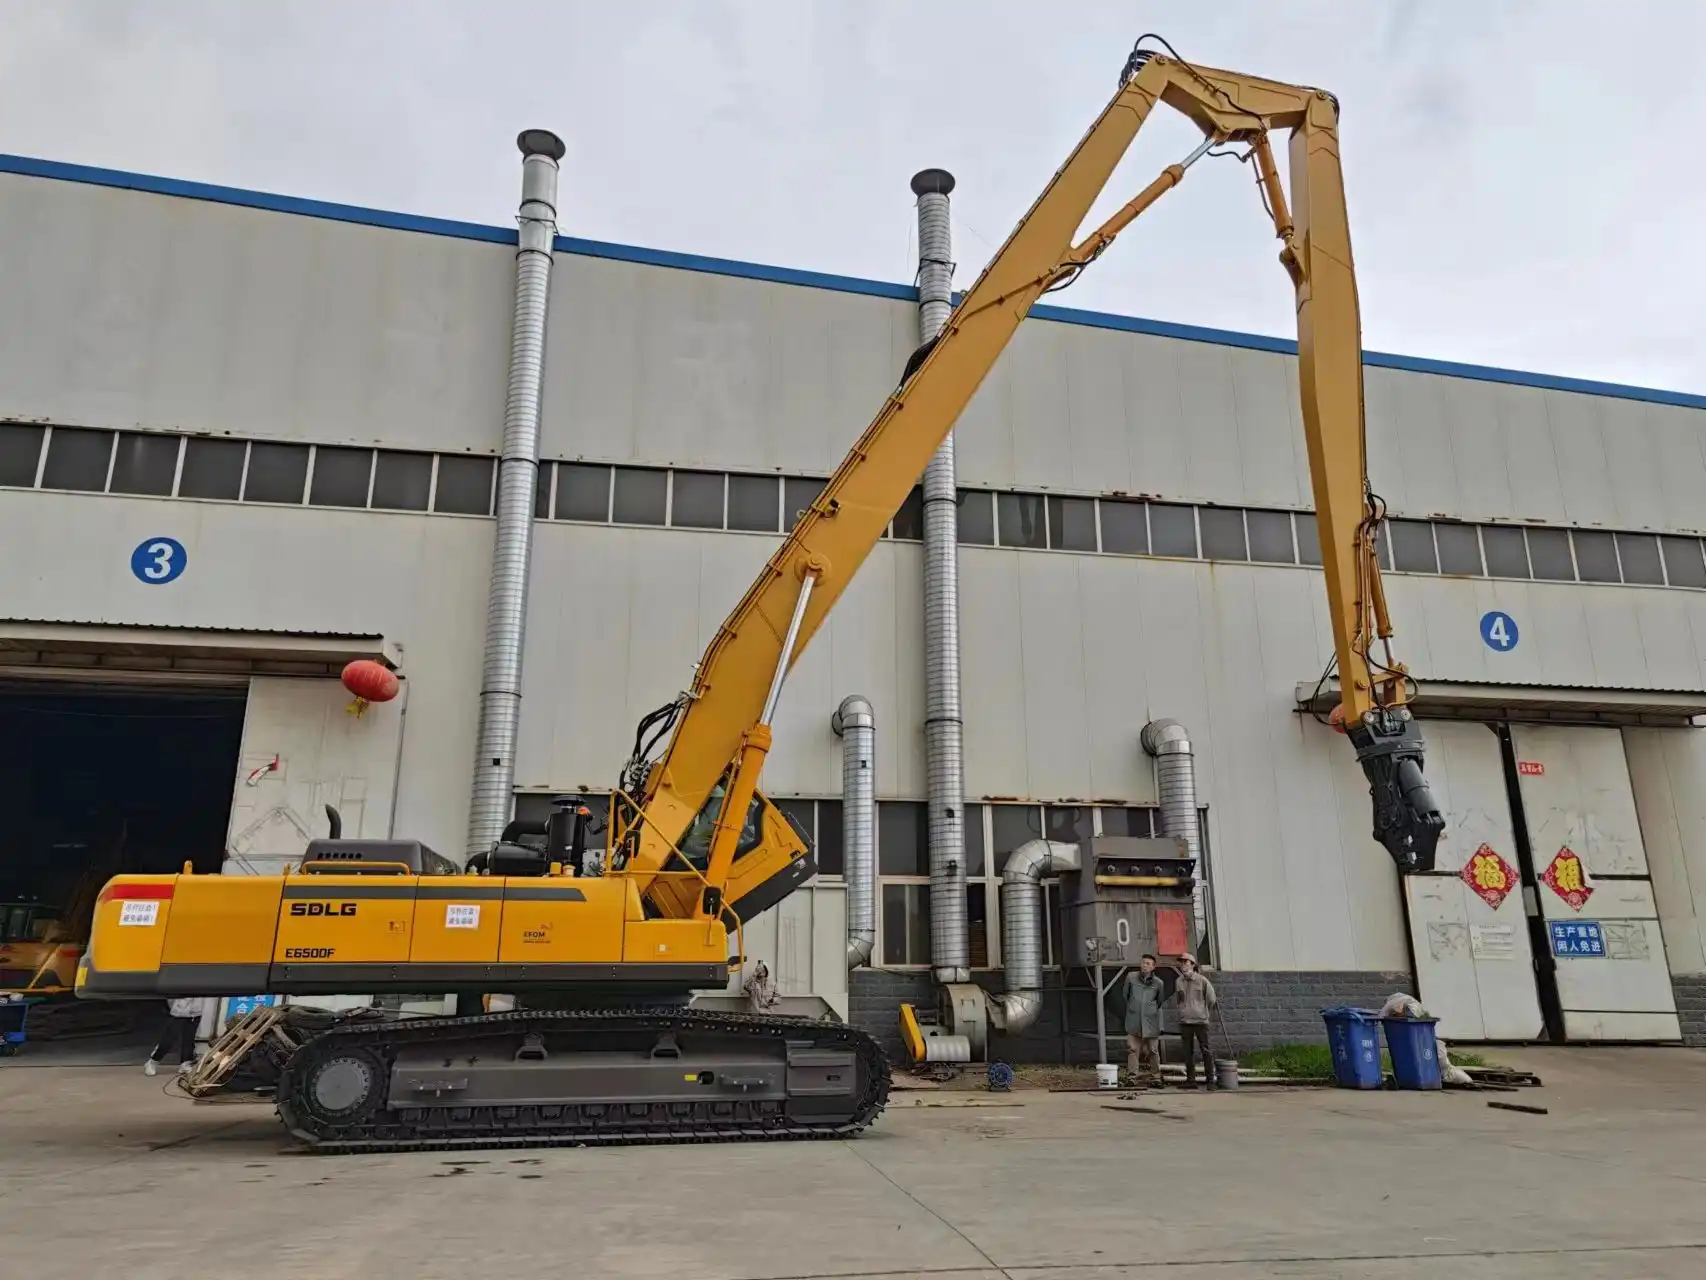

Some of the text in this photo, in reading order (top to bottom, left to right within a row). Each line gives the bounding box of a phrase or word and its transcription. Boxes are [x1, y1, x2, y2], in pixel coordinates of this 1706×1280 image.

[144, 542, 174, 579] 3
[1489, 616, 1511, 647] 4
[1473, 854, 1507, 890] 福
[290, 902, 357, 917] SDLG
[1554, 926, 1599, 938] 生产重地
[285, 948, 336, 959] E6500F
[1556, 940, 1602, 953] 闲人免进
